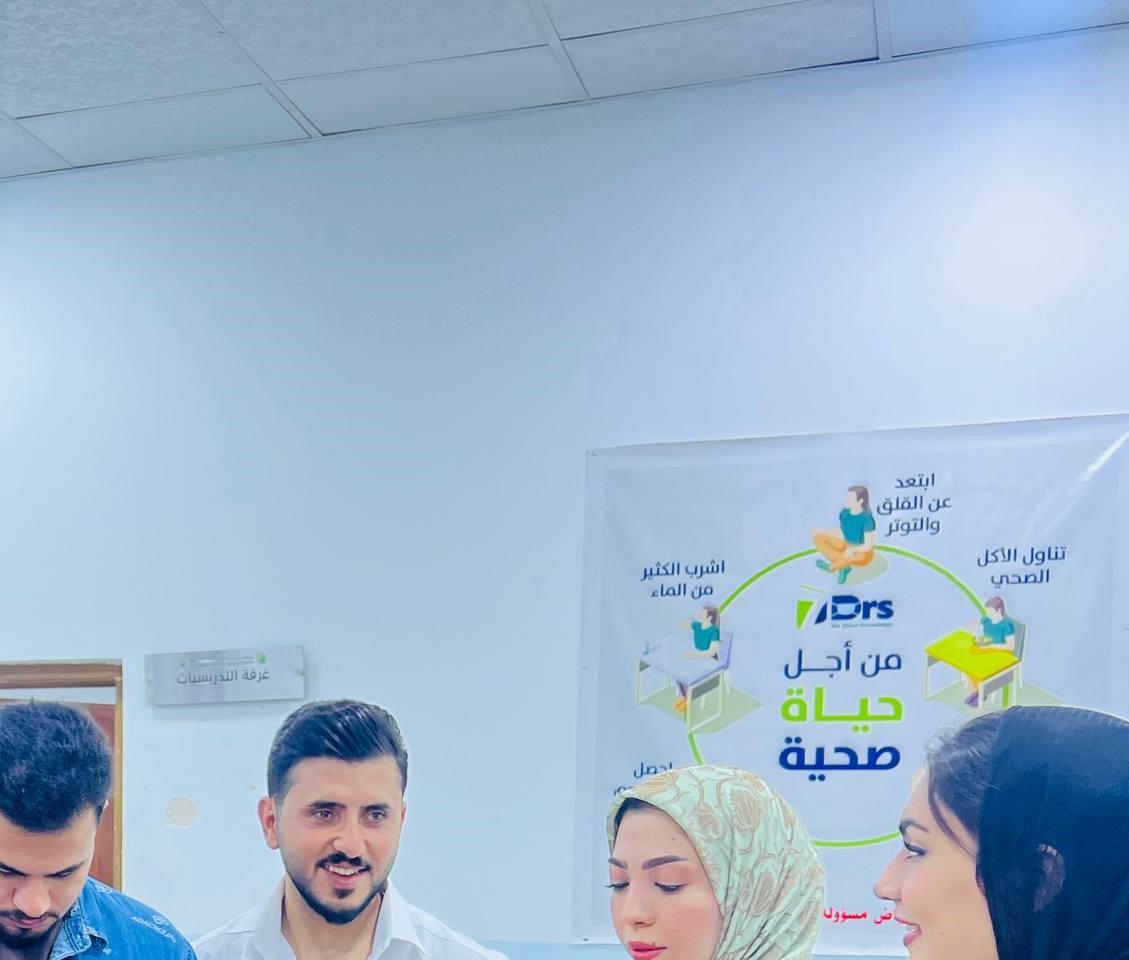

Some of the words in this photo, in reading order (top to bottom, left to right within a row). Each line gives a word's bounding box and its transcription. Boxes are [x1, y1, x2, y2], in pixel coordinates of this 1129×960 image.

[894, 473, 936, 491] ابتعد
[876, 495, 923, 516] القلق
[928, 497, 952, 514] عن
[884, 517, 941, 537] والتوتر
[976, 547, 1019, 569] الأكل
[1021, 545, 1068, 567] تناول
[639, 561, 684, 584] الكثير
[685, 559, 726, 583] اشرب
[989, 568, 1050, 588] الصحي
[650, 582, 688, 600] الماء
[690, 583, 714, 600] من
[783, 641, 852, 681] أجل
[860, 650, 903, 678] من
[242, 668, 271, 683] غرفة
[779, 686, 904, 734] حياة
[778, 737, 901, 781] صحية
